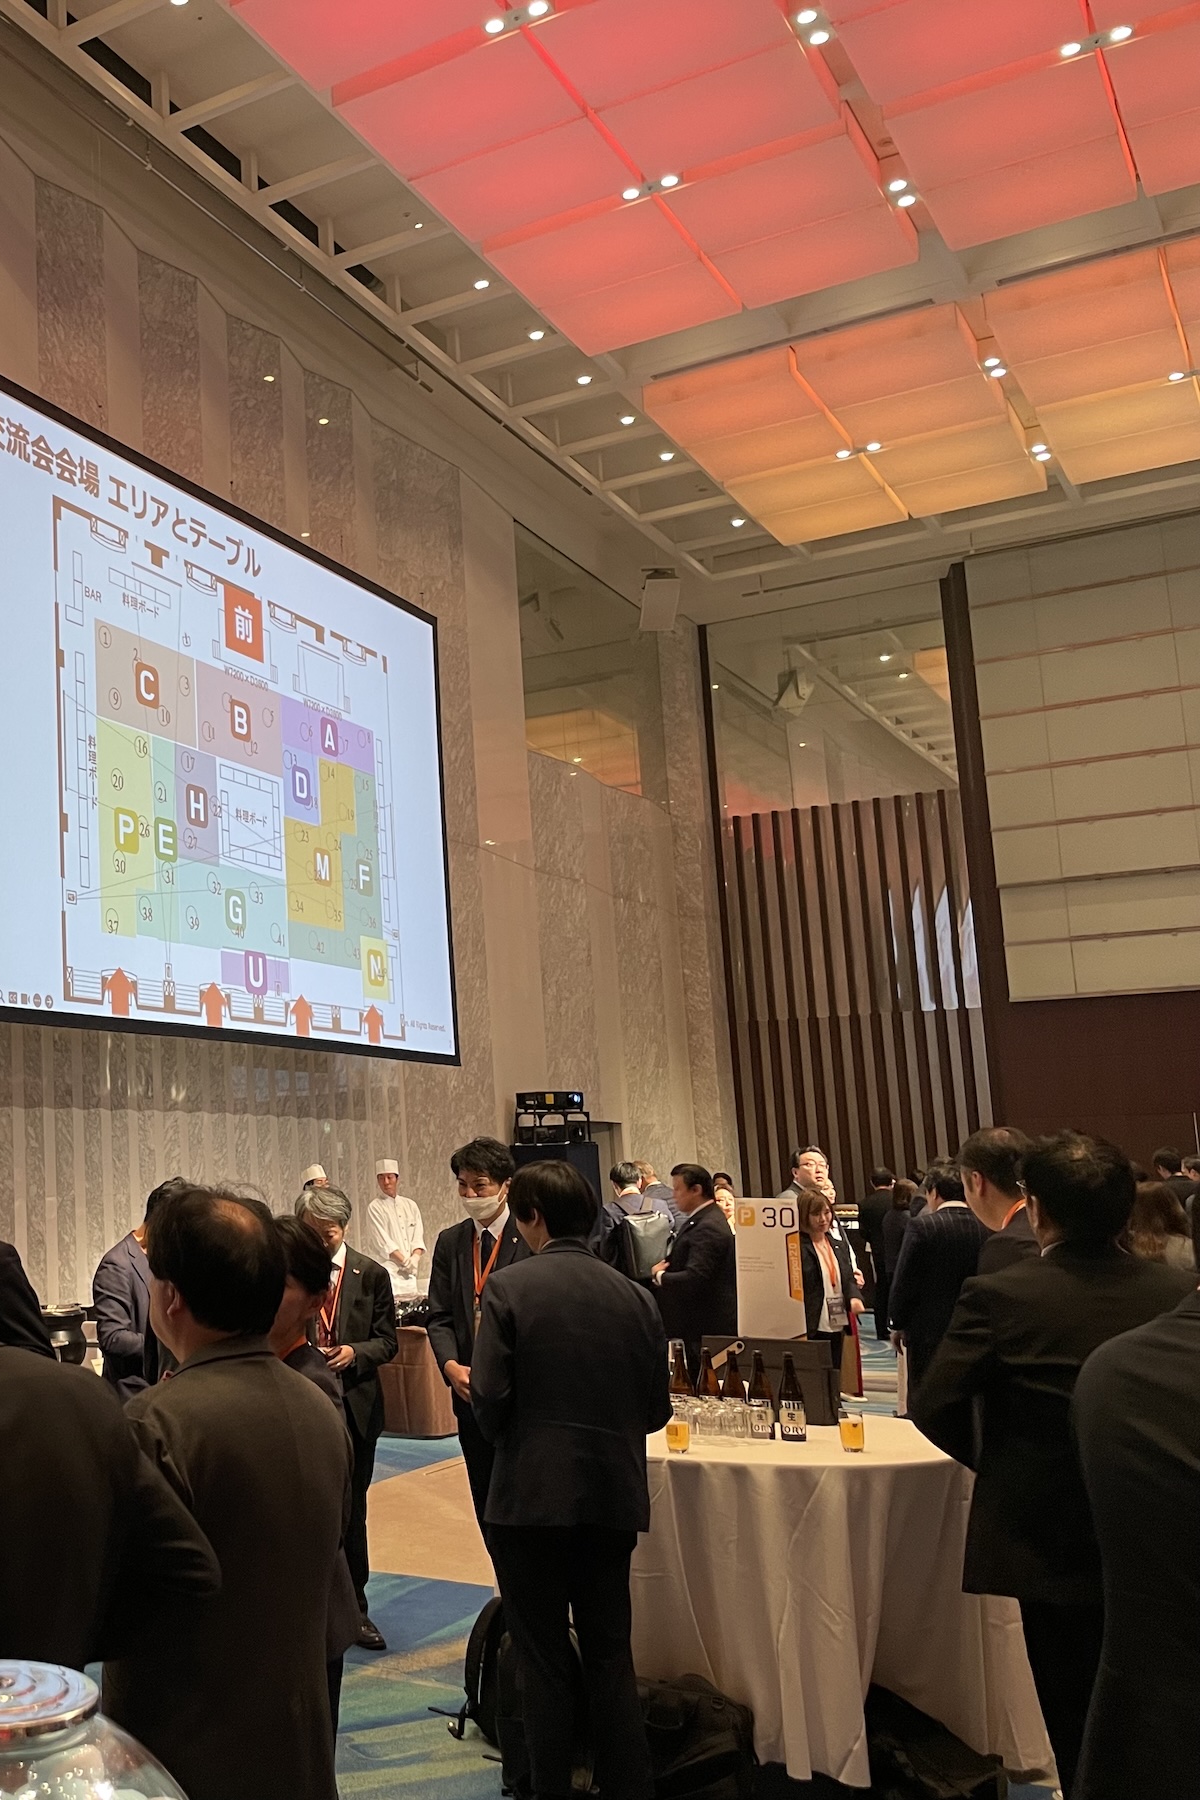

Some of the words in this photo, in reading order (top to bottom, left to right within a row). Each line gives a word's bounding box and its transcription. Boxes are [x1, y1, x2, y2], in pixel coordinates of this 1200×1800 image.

[108, 475, 262, 578] エリアとテーブル
[84, 586, 102, 603] BAR
[234, 605, 253, 644] 前
[140, 669, 155, 701] C
[234, 705, 247, 736] B
[324, 723, 336, 752] A
[295, 770, 308, 800] D
[189, 789, 205, 822] H
[118, 812, 135, 845] P
[158, 823, 174, 856] E
[316, 852, 330, 882] M
[358, 864, 371, 890] F
[229, 894, 243, 925] G
[248, 955, 263, 988] U
[370, 954, 383, 982] N
[762, 1207, 795, 1228] 30
